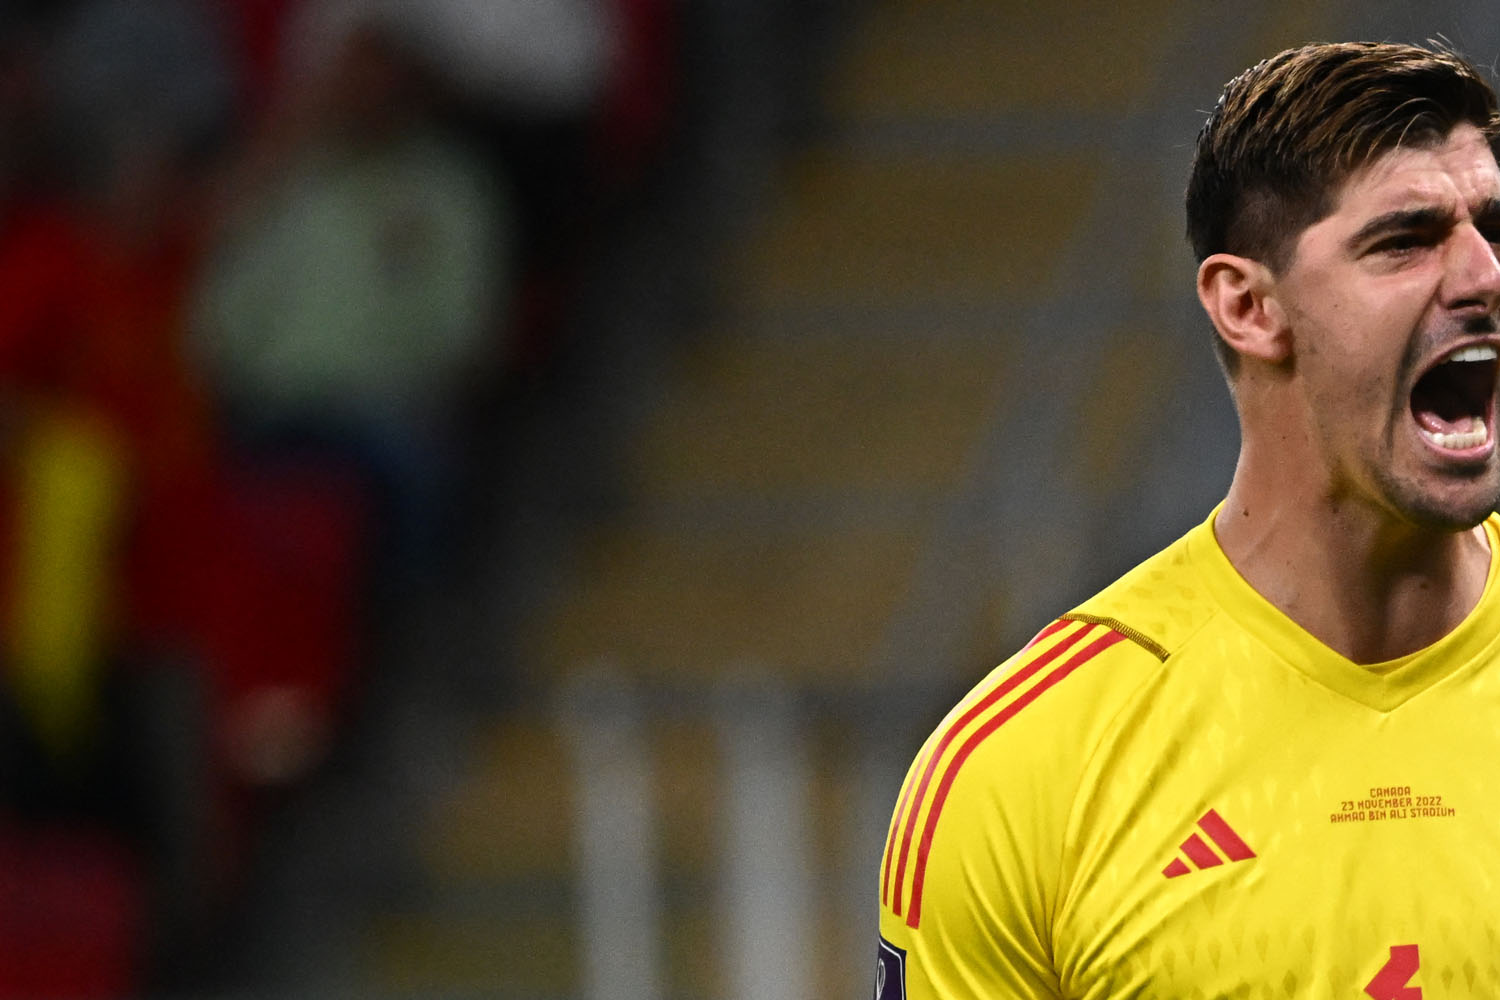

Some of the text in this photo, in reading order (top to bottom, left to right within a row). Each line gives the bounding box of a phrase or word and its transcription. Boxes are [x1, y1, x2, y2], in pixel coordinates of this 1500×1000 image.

[1370, 786, 1411, 798] CANADA
[1341, 796, 1442, 811] 23 NOVEMBER 2022
[1330, 807, 1455, 823] AHMAD BIN ALI STADIUM
